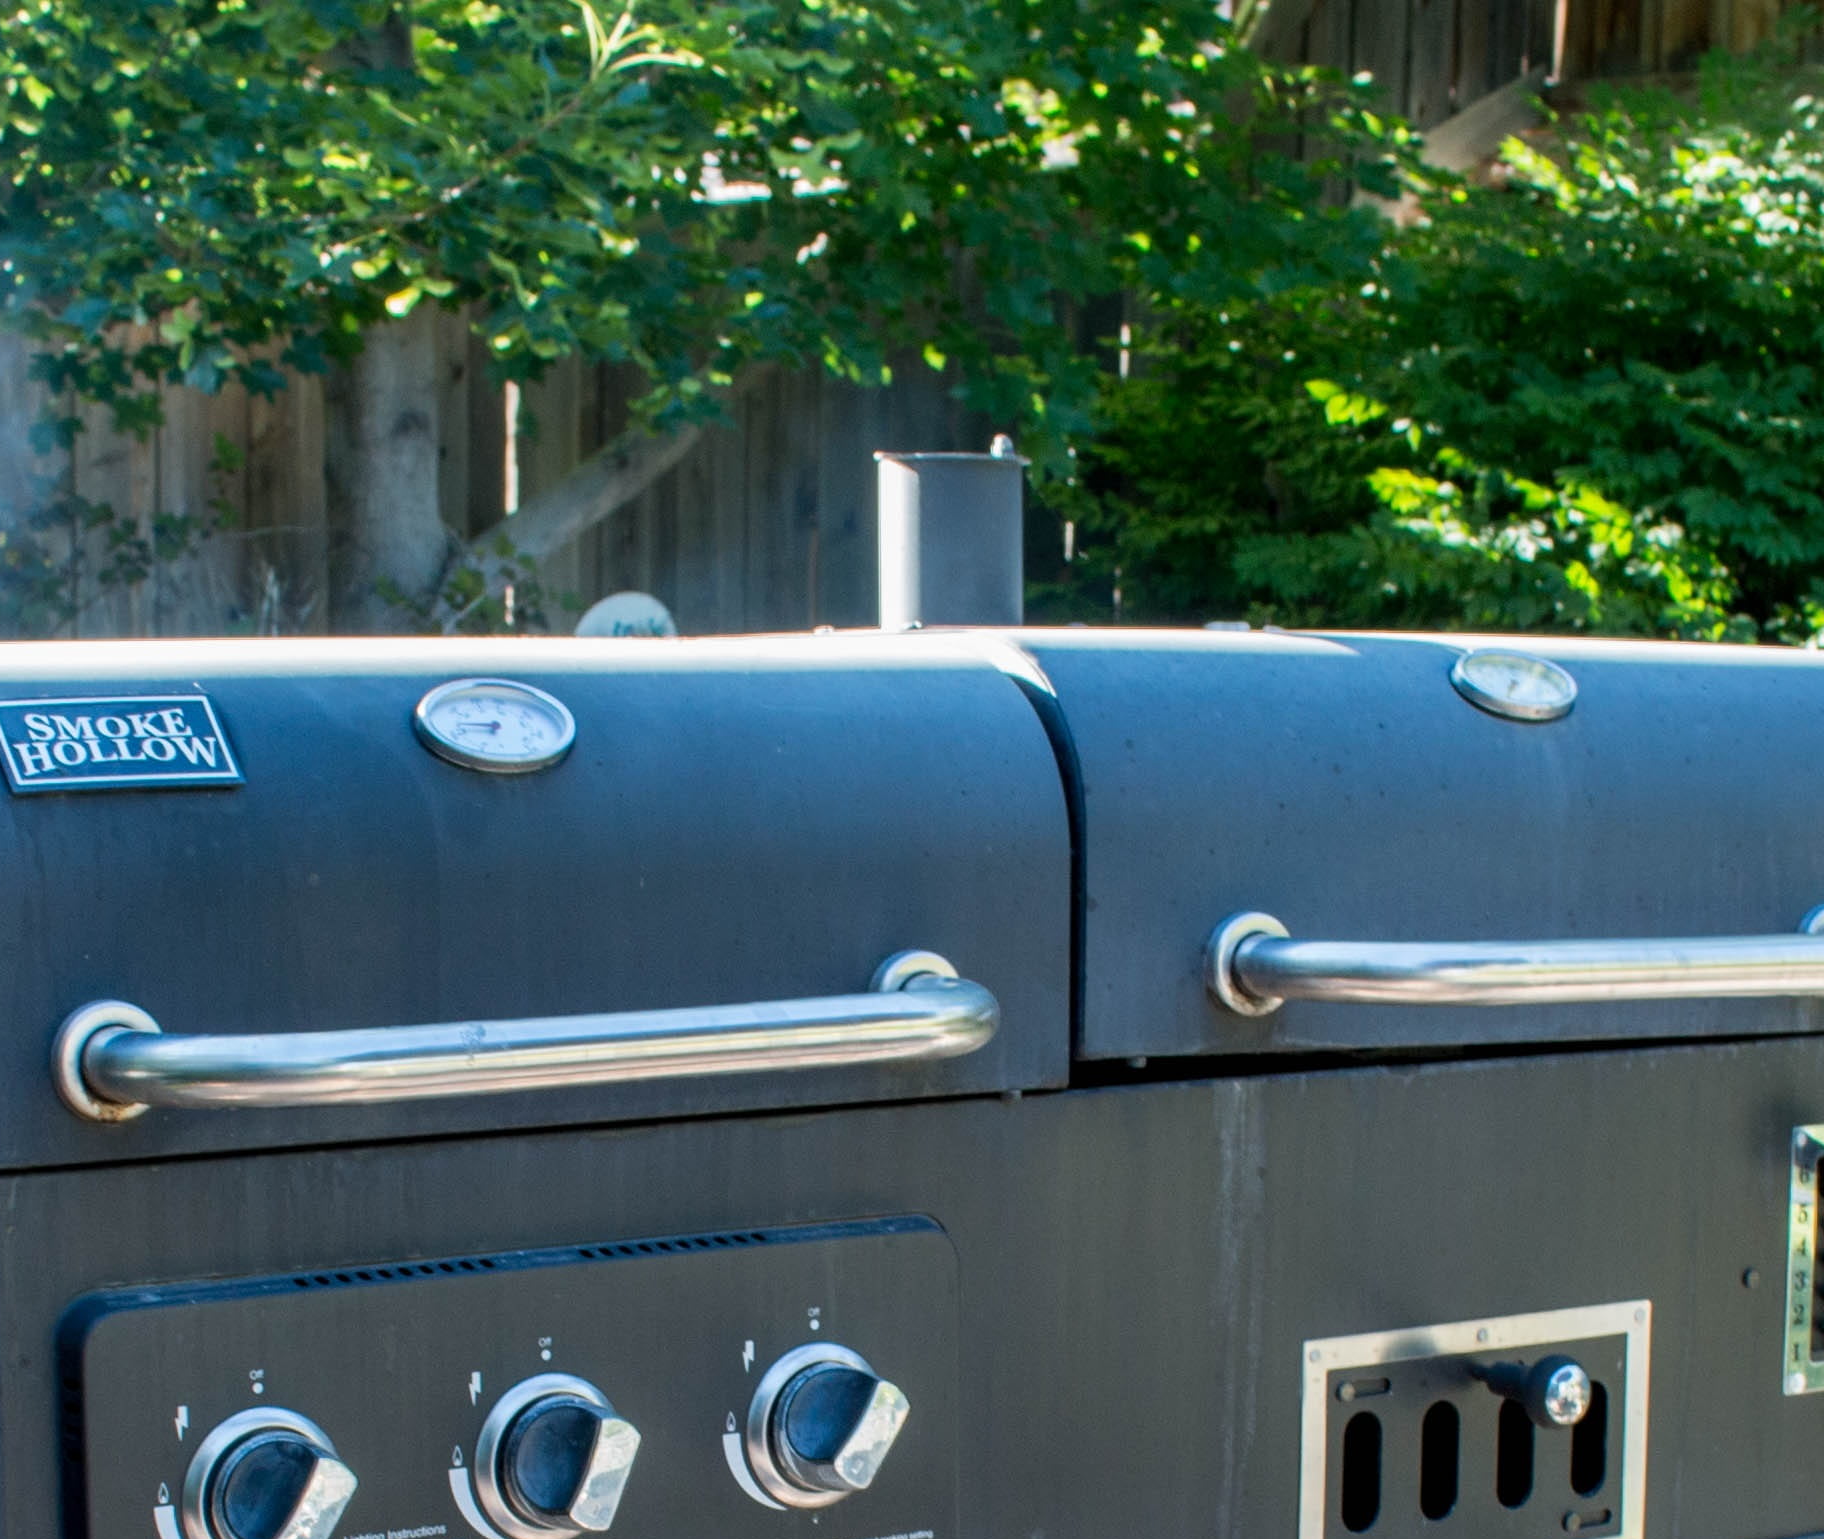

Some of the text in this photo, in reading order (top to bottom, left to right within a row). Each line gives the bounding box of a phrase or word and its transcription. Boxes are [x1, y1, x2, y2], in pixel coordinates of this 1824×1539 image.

[23, 708, 192, 742] SMOKE
[12, 735, 217, 777] HOLLOW
[1793, 1305, 1805, 1325] 2
